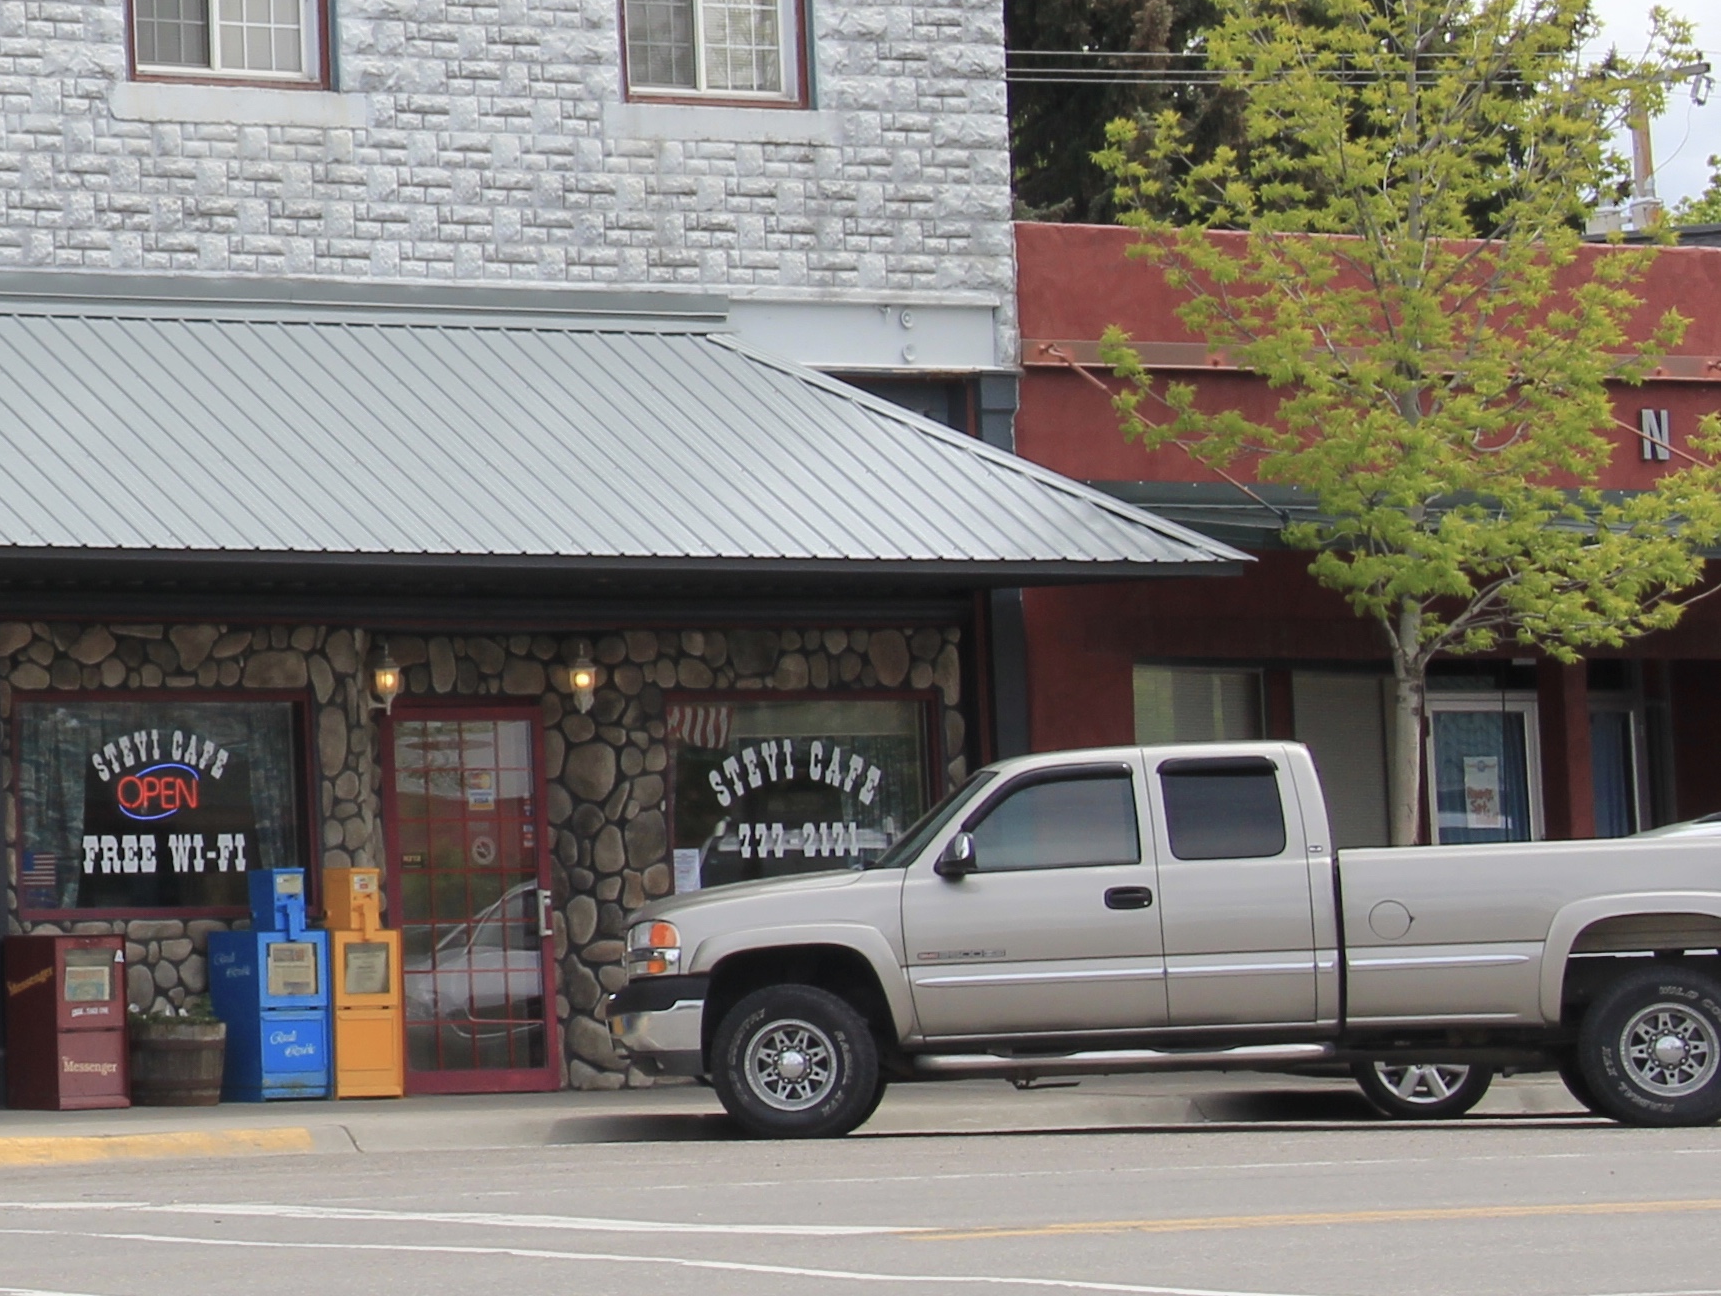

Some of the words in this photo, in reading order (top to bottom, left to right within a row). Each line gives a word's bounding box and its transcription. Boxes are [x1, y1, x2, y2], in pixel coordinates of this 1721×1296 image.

[1641, 408, 1670, 460] N
[91, 728, 160, 782] STEVI
[171, 729, 229, 780] CAFE
[708, 738, 794, 807] STEVI
[809, 740, 882, 805] CAFE
[117, 775, 198, 809] OPEN
[82, 834, 157, 874] FREE
[168, 833, 247, 873] WI-FI
[738, 821, 859, 859] 777-2171
[63, 1060, 118, 1076] Messenger
